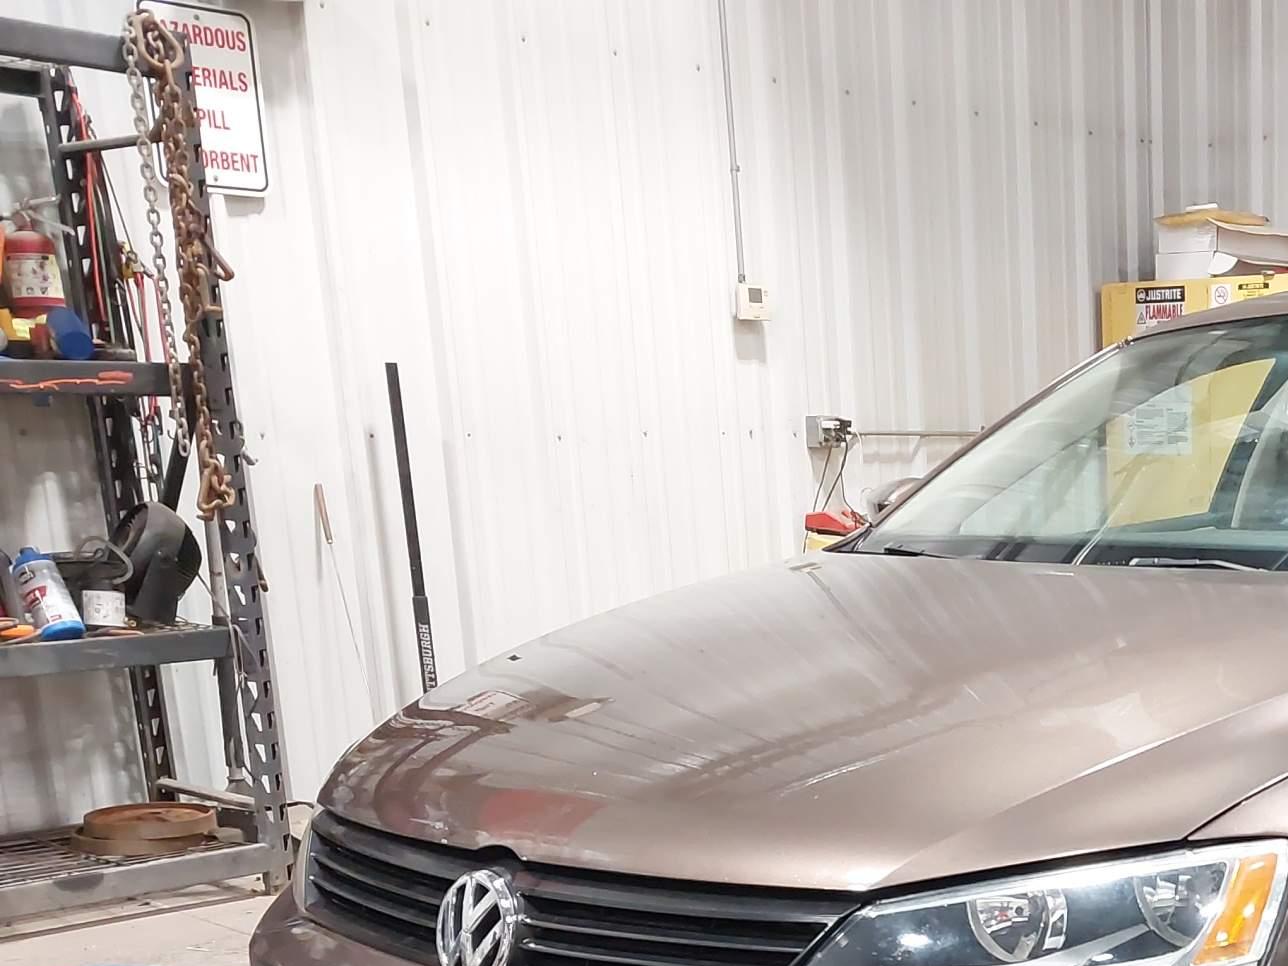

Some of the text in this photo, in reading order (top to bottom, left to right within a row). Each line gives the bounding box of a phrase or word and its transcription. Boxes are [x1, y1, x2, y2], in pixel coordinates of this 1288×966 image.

[192, 66, 249, 92] ERIALS
[197, 107, 231, 130] PILL
[201, 149, 259, 174] ORBENT
[1145, 288, 1182, 301] JUSTRITE
[1145, 304, 1183, 320] FLAMMABLE
[418, 623, 436, 691] TTSBURGH
